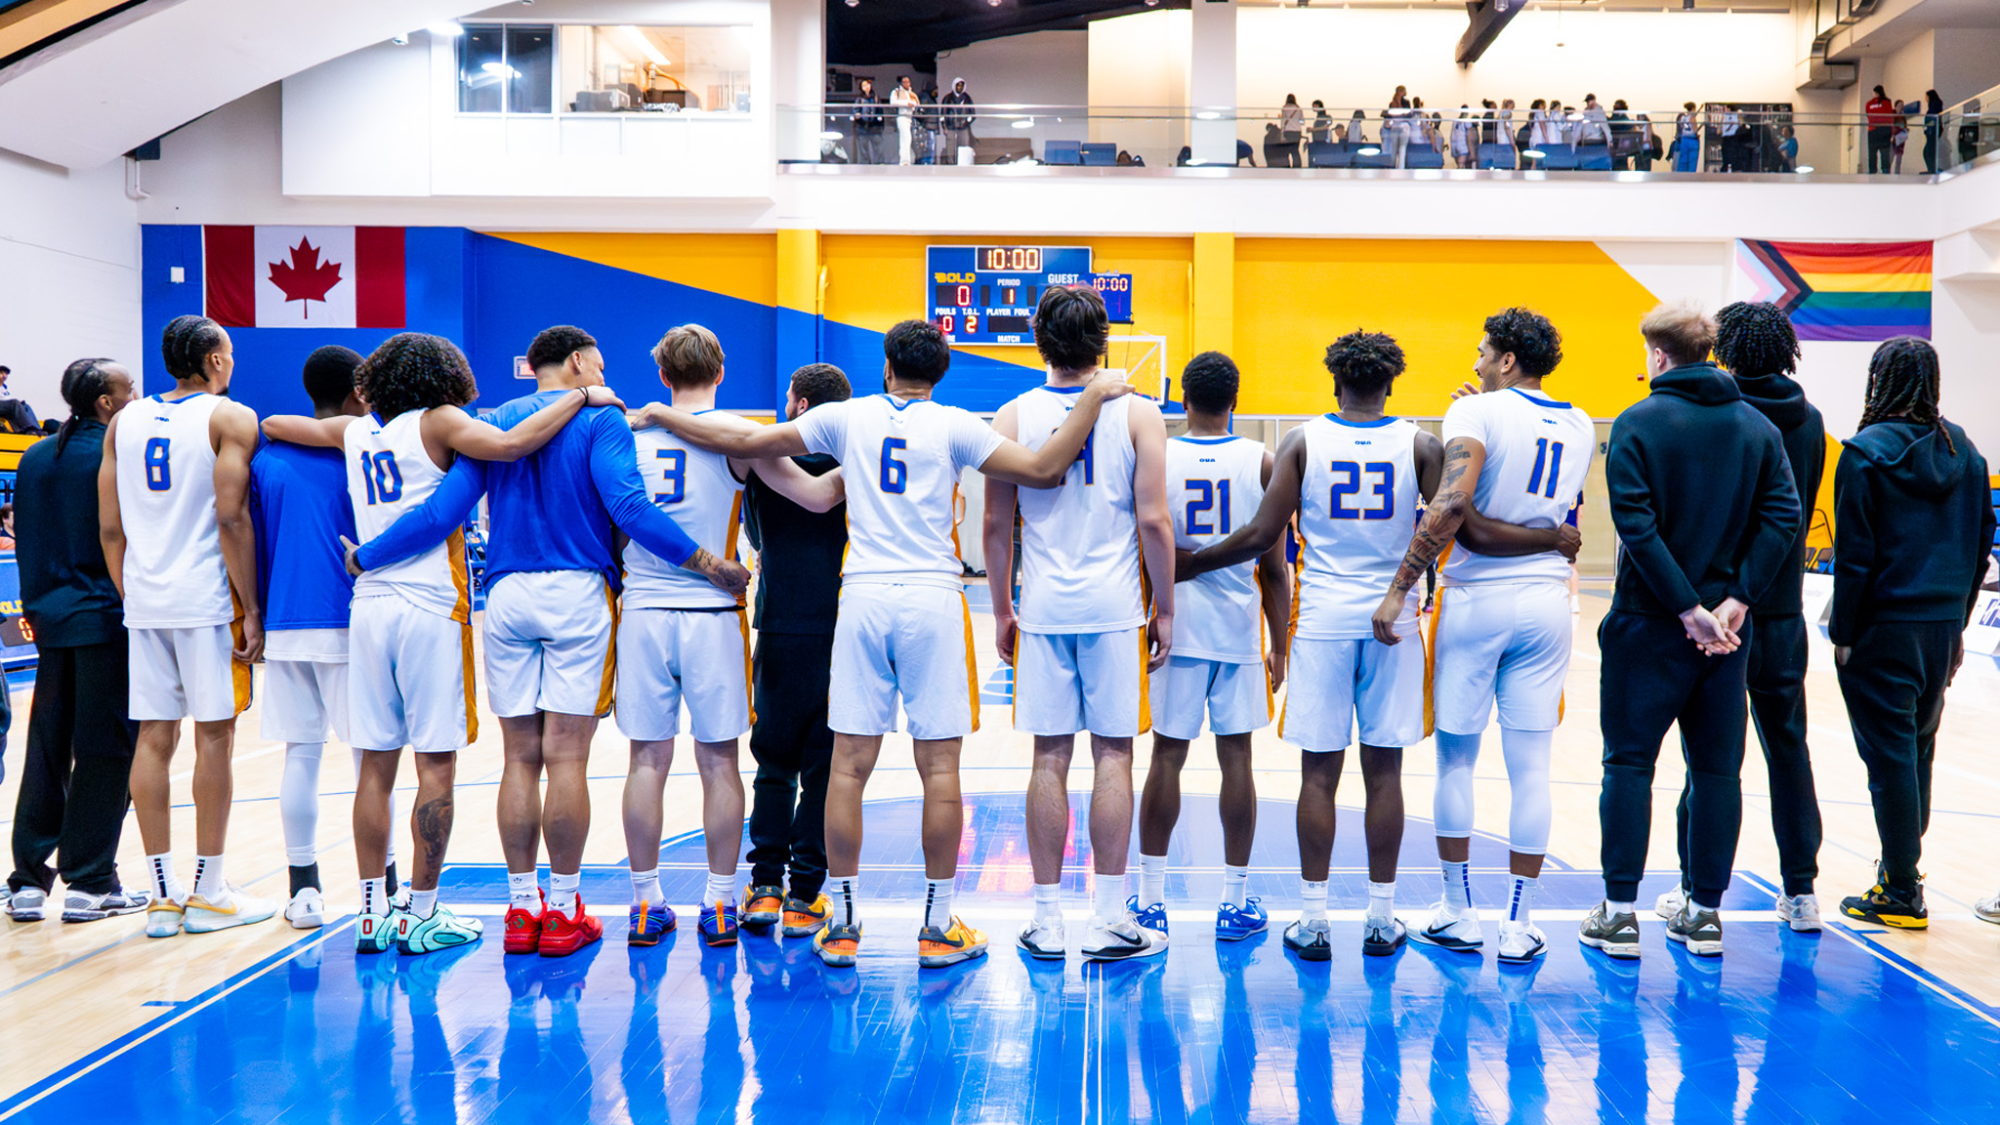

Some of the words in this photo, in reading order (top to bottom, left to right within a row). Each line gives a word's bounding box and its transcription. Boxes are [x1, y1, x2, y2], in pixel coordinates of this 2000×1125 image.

[987, 248, 1039, 270] 10:00
[934, 272, 976, 283] BOLD
[1048, 274, 1079, 284] GUEST
[1092, 277, 1129, 292] 10:00
[957, 285, 970, 306] 0
[1009, 288, 1014, 304] 1
[935, 308, 956, 316] FOULS
[986, 308, 1011, 316] PLAYER
[1014, 308, 1030, 316] FOUL
[942, 315, 953, 332] 0
[965, 315, 978, 333] 2
[997, 335, 1021, 343] MATCH
[144, 436, 172, 492] 8
[879, 435, 908, 496] 6
[1526, 436, 1565, 500] 11
[359, 448, 404, 507] 10
[654, 448, 688, 504] 3
[1329, 460, 1396, 521] 23
[1184, 478, 1231, 537] 21
[362, 918, 373, 935] 0
[398, 918, 408, 935] 0
